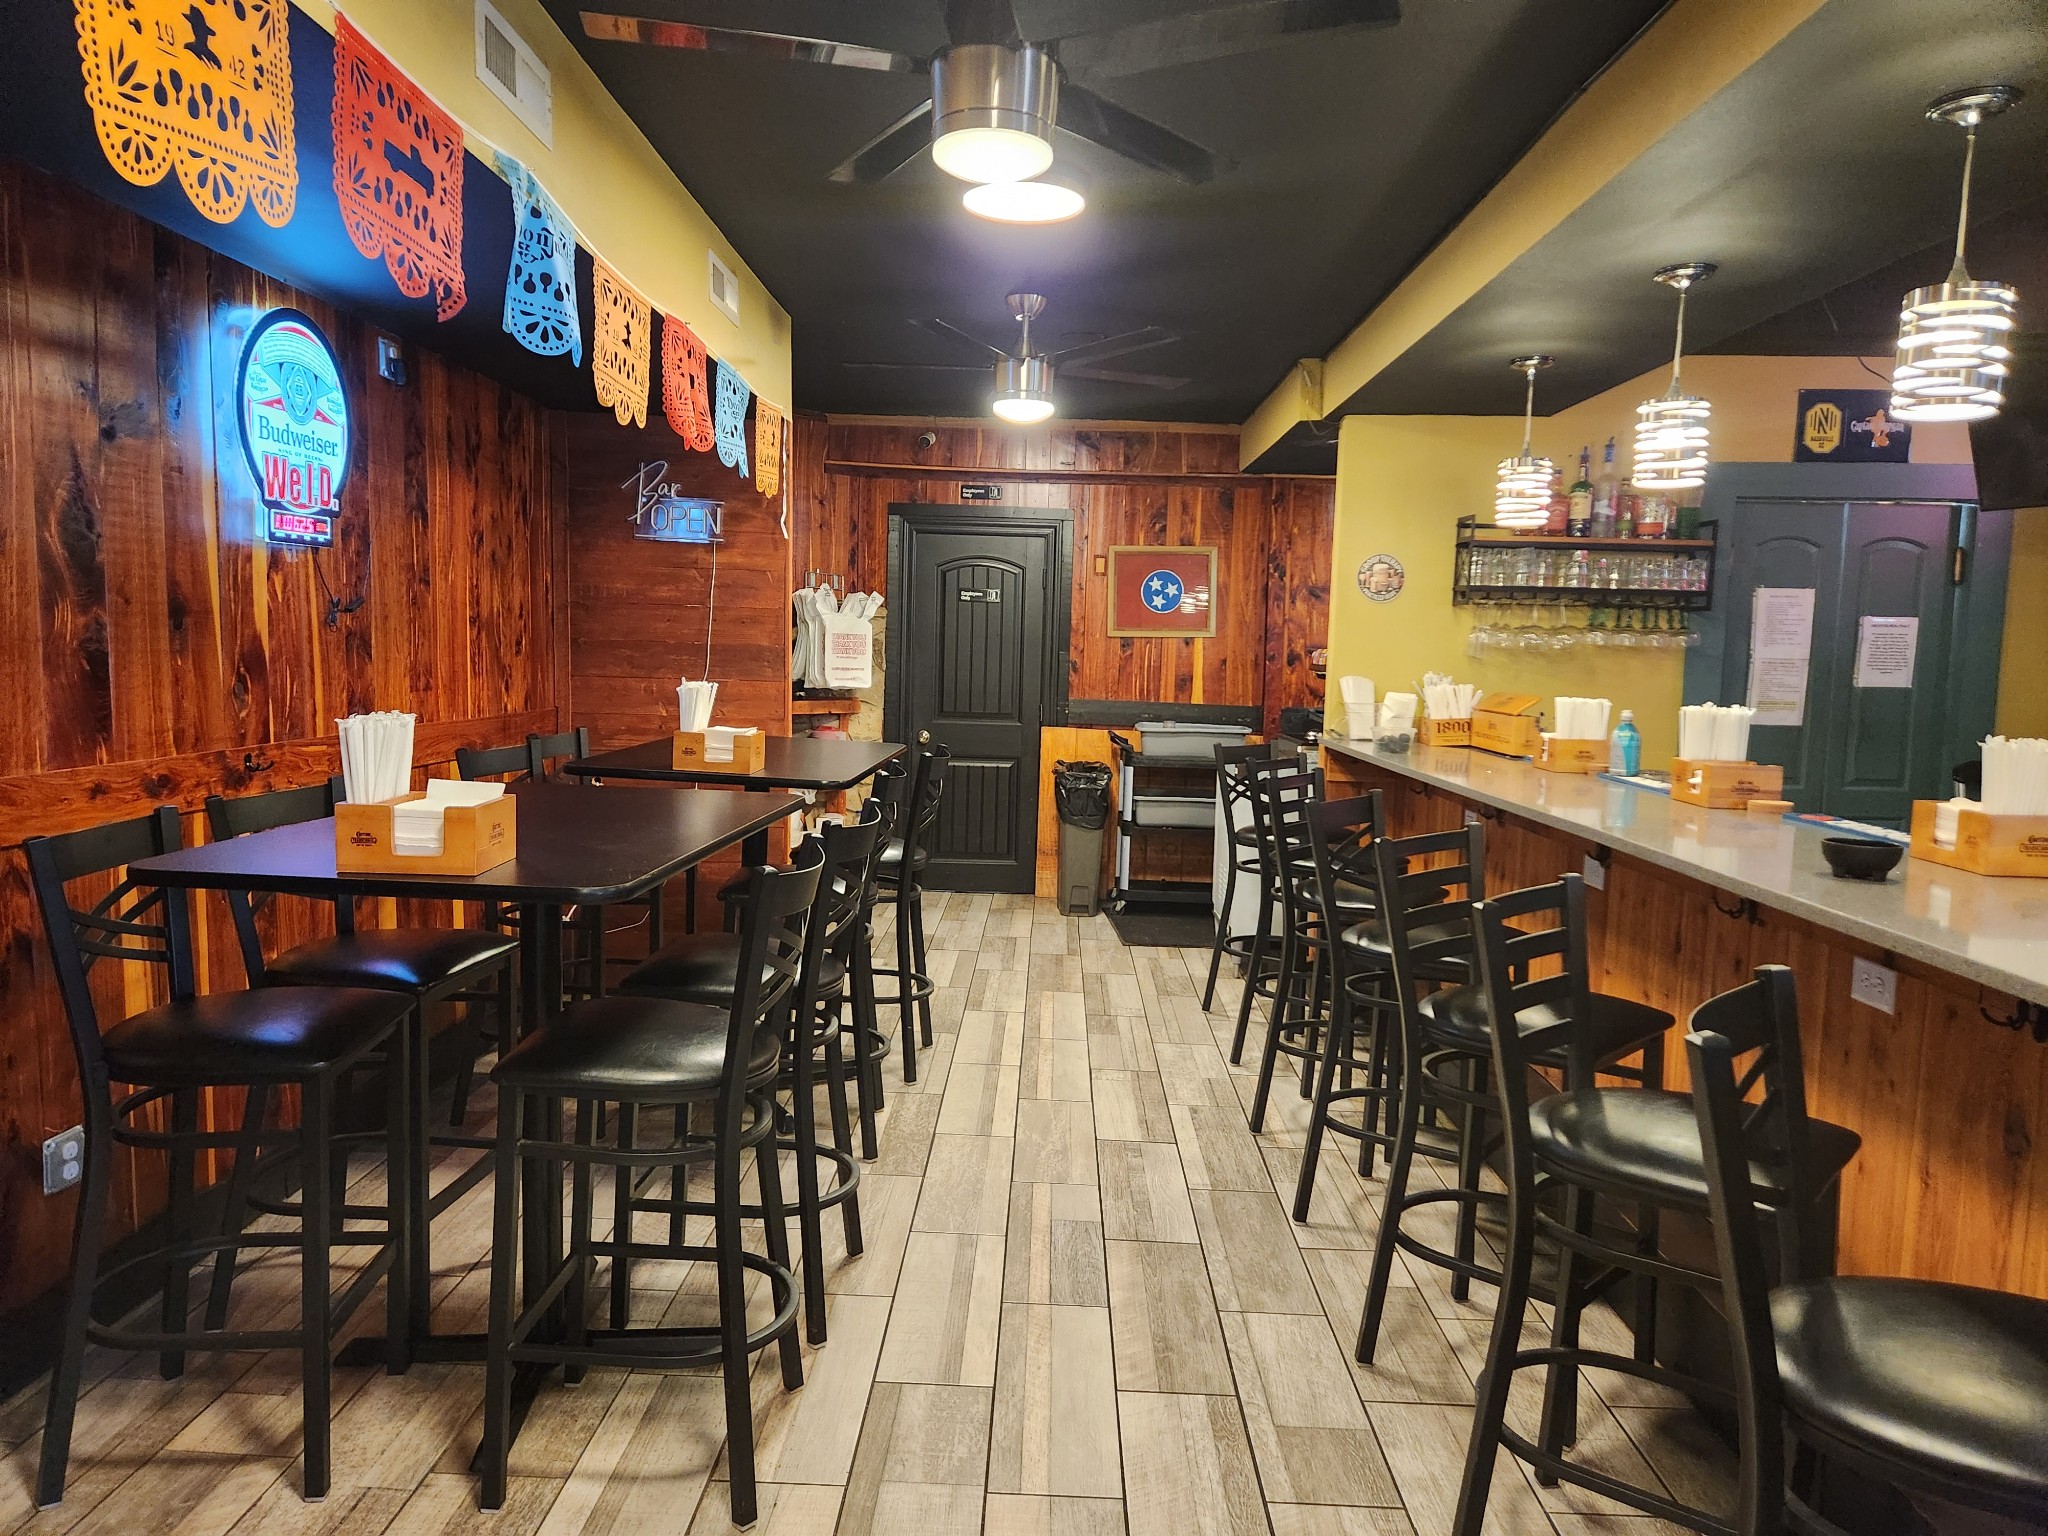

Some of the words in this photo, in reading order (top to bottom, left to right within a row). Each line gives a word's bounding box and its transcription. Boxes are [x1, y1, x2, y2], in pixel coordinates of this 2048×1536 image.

[155, 19, 174, 47] 19
[258, 415, 338, 457] Budweiser
[278, 448, 293, 456] KING
[263, 452, 302, 504] We
[621, 460, 682, 525] Bar
[650, 504, 722, 535] OPEN
[1436, 721, 1471, 733] 1800
